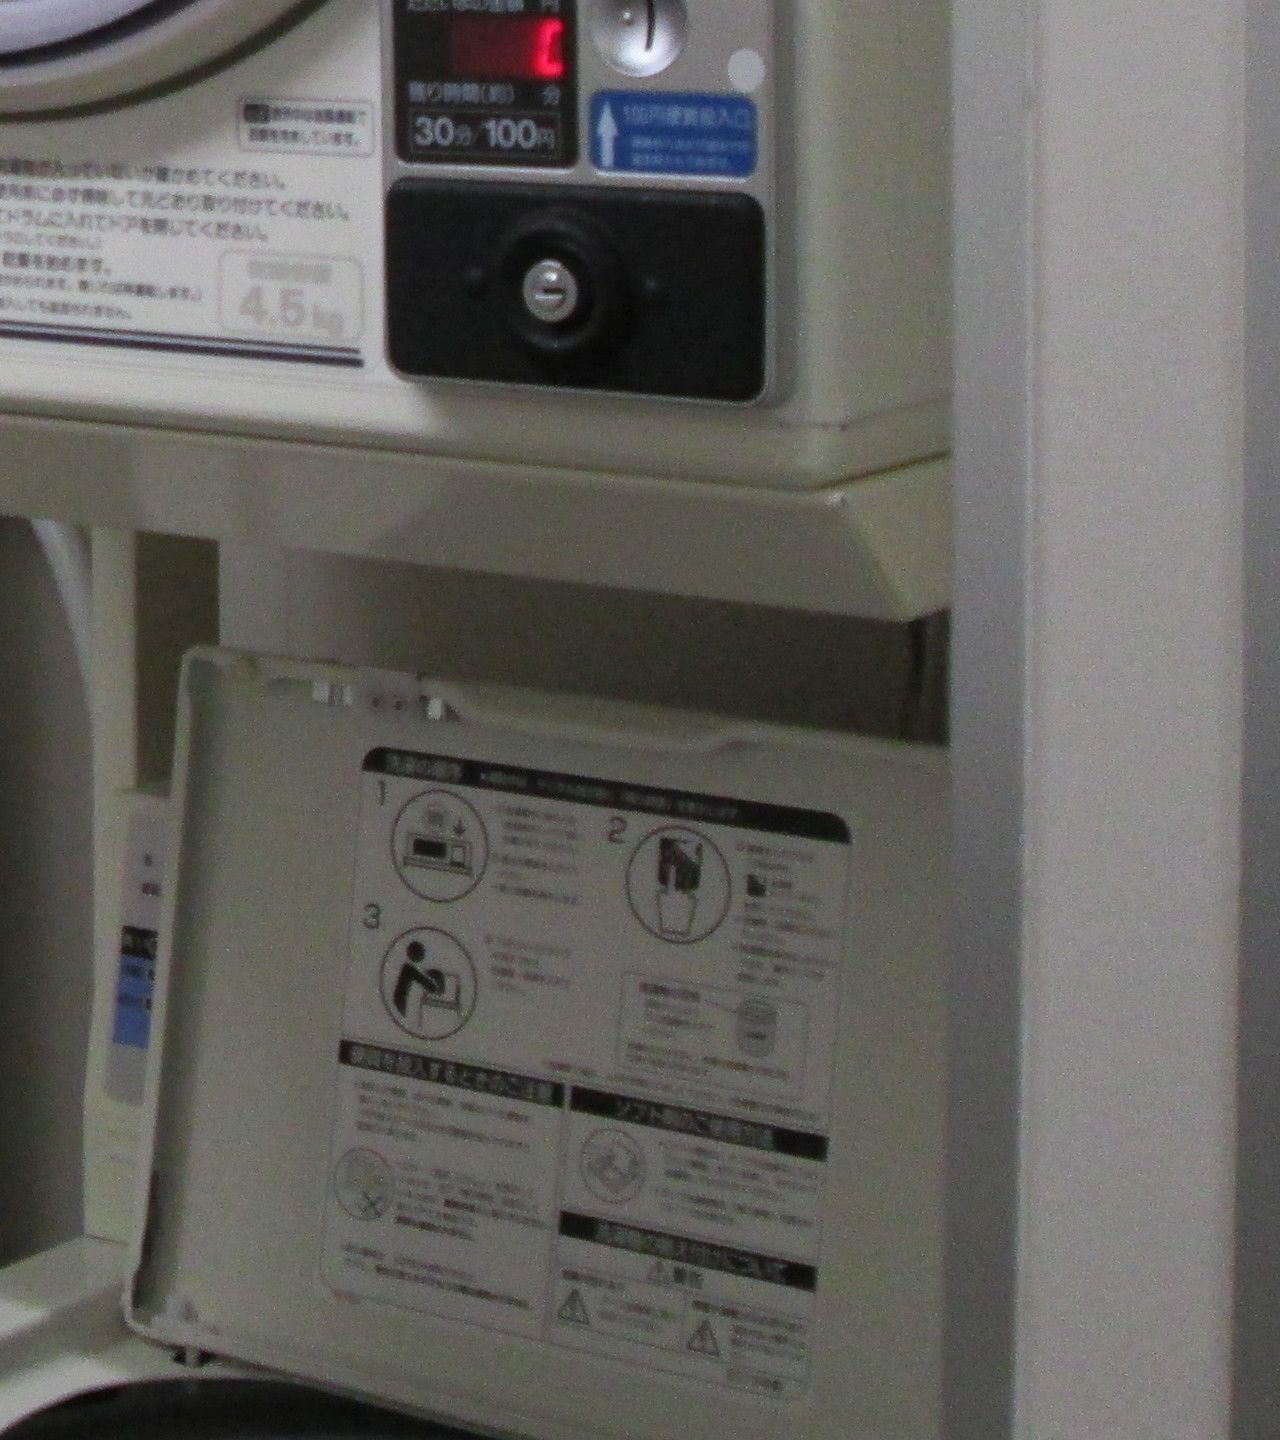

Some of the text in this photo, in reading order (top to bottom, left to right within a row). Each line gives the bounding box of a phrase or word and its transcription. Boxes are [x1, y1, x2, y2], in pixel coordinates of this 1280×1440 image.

[376, 781, 387, 806] 1
[607, 816, 628, 844] 2
[362, 903, 382, 930] 3
